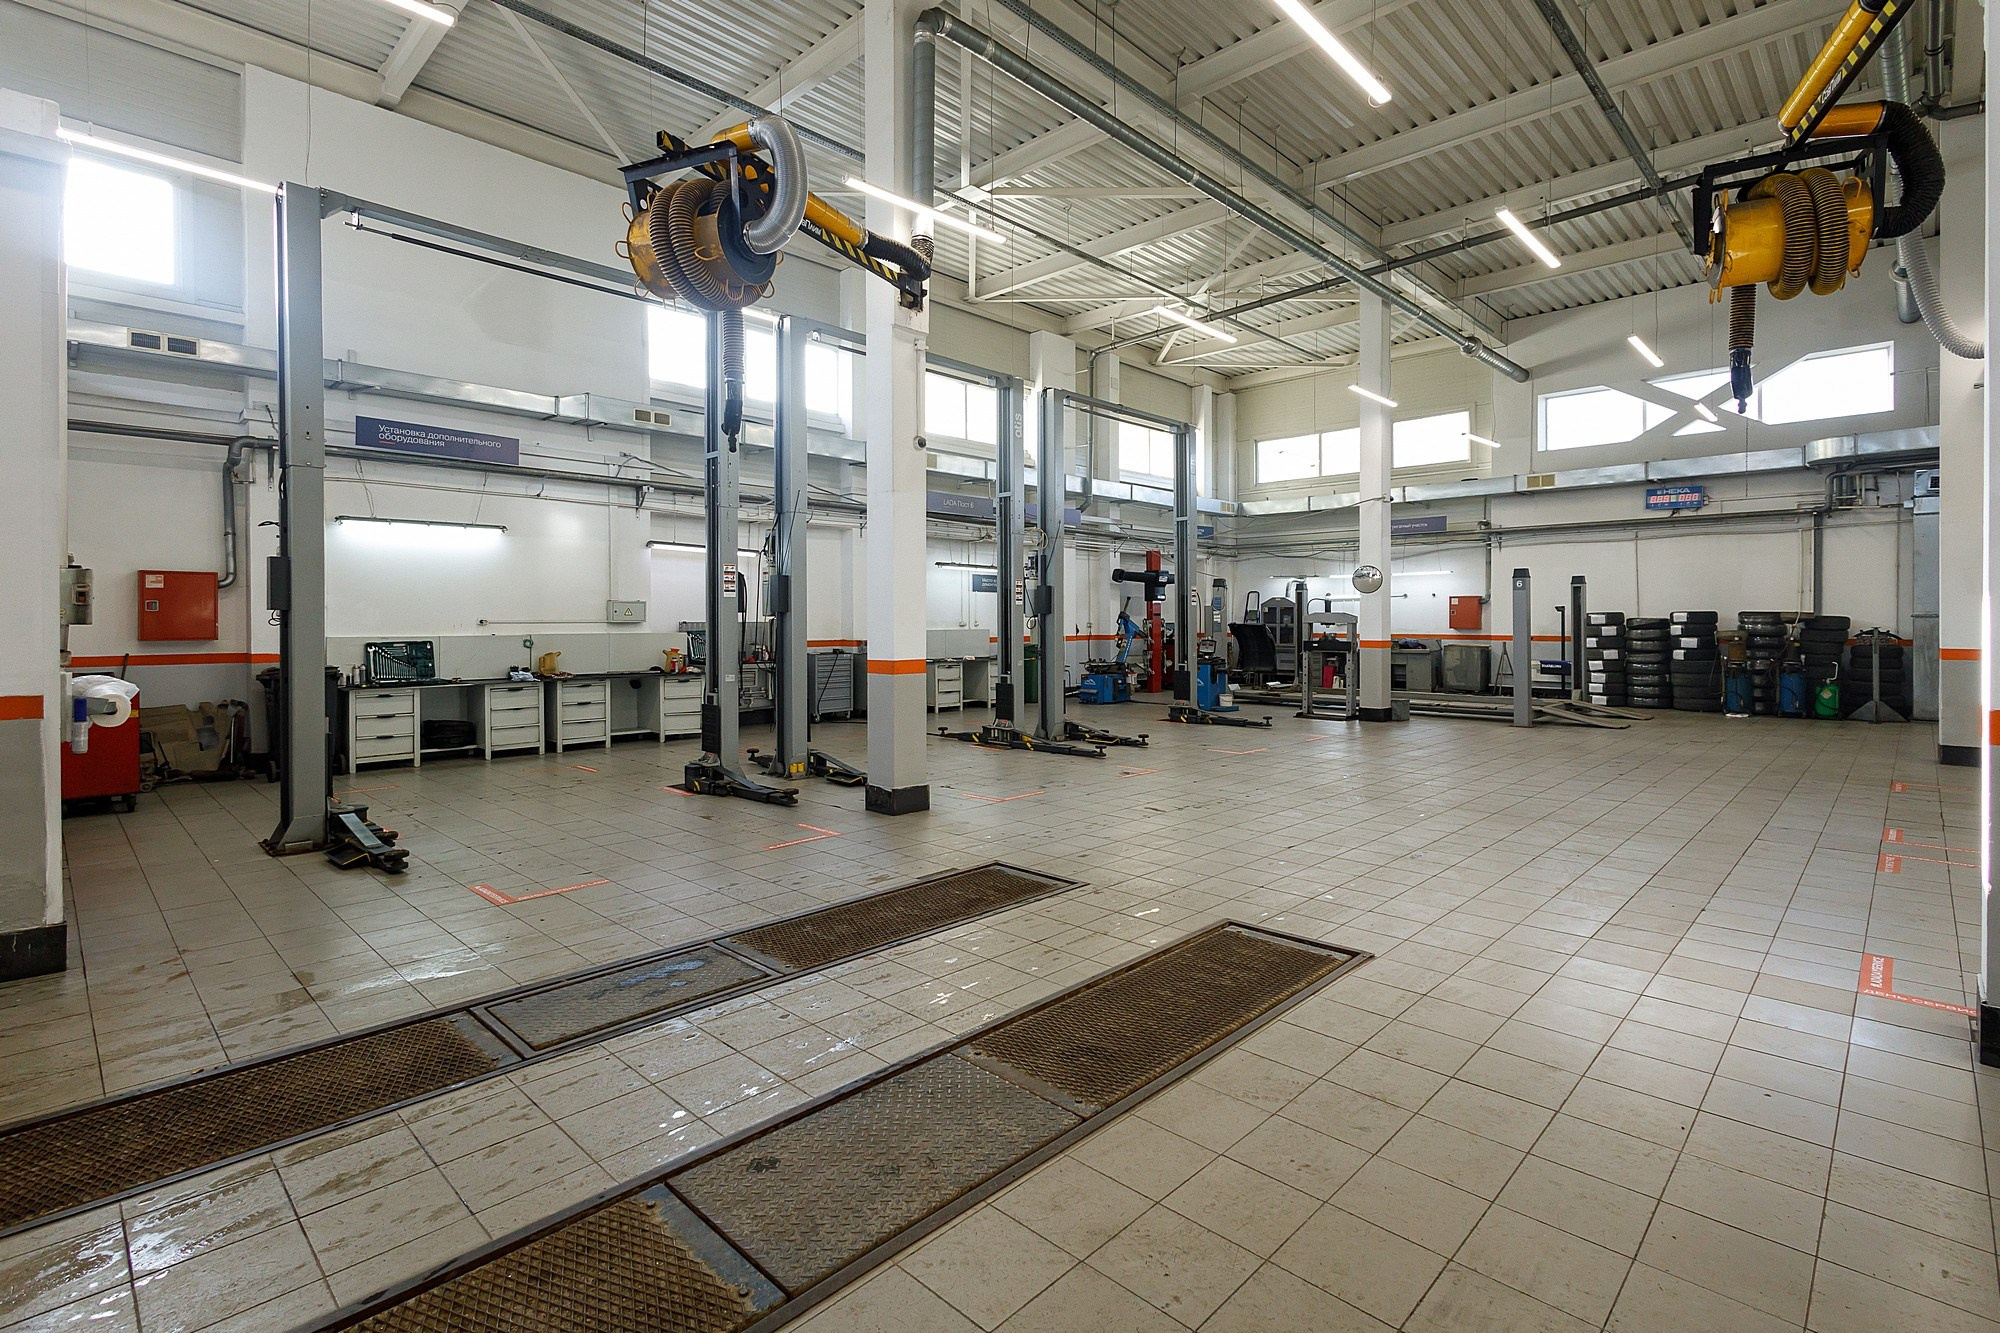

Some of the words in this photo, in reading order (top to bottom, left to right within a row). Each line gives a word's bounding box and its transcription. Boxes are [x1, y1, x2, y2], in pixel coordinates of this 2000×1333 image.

[378, 424, 426, 438] Установка
[427, 432, 502, 448] дополнительного
[378, 433, 445, 447] оборудования
[1863, 989, 1907, 1001] ДЕНЬ
